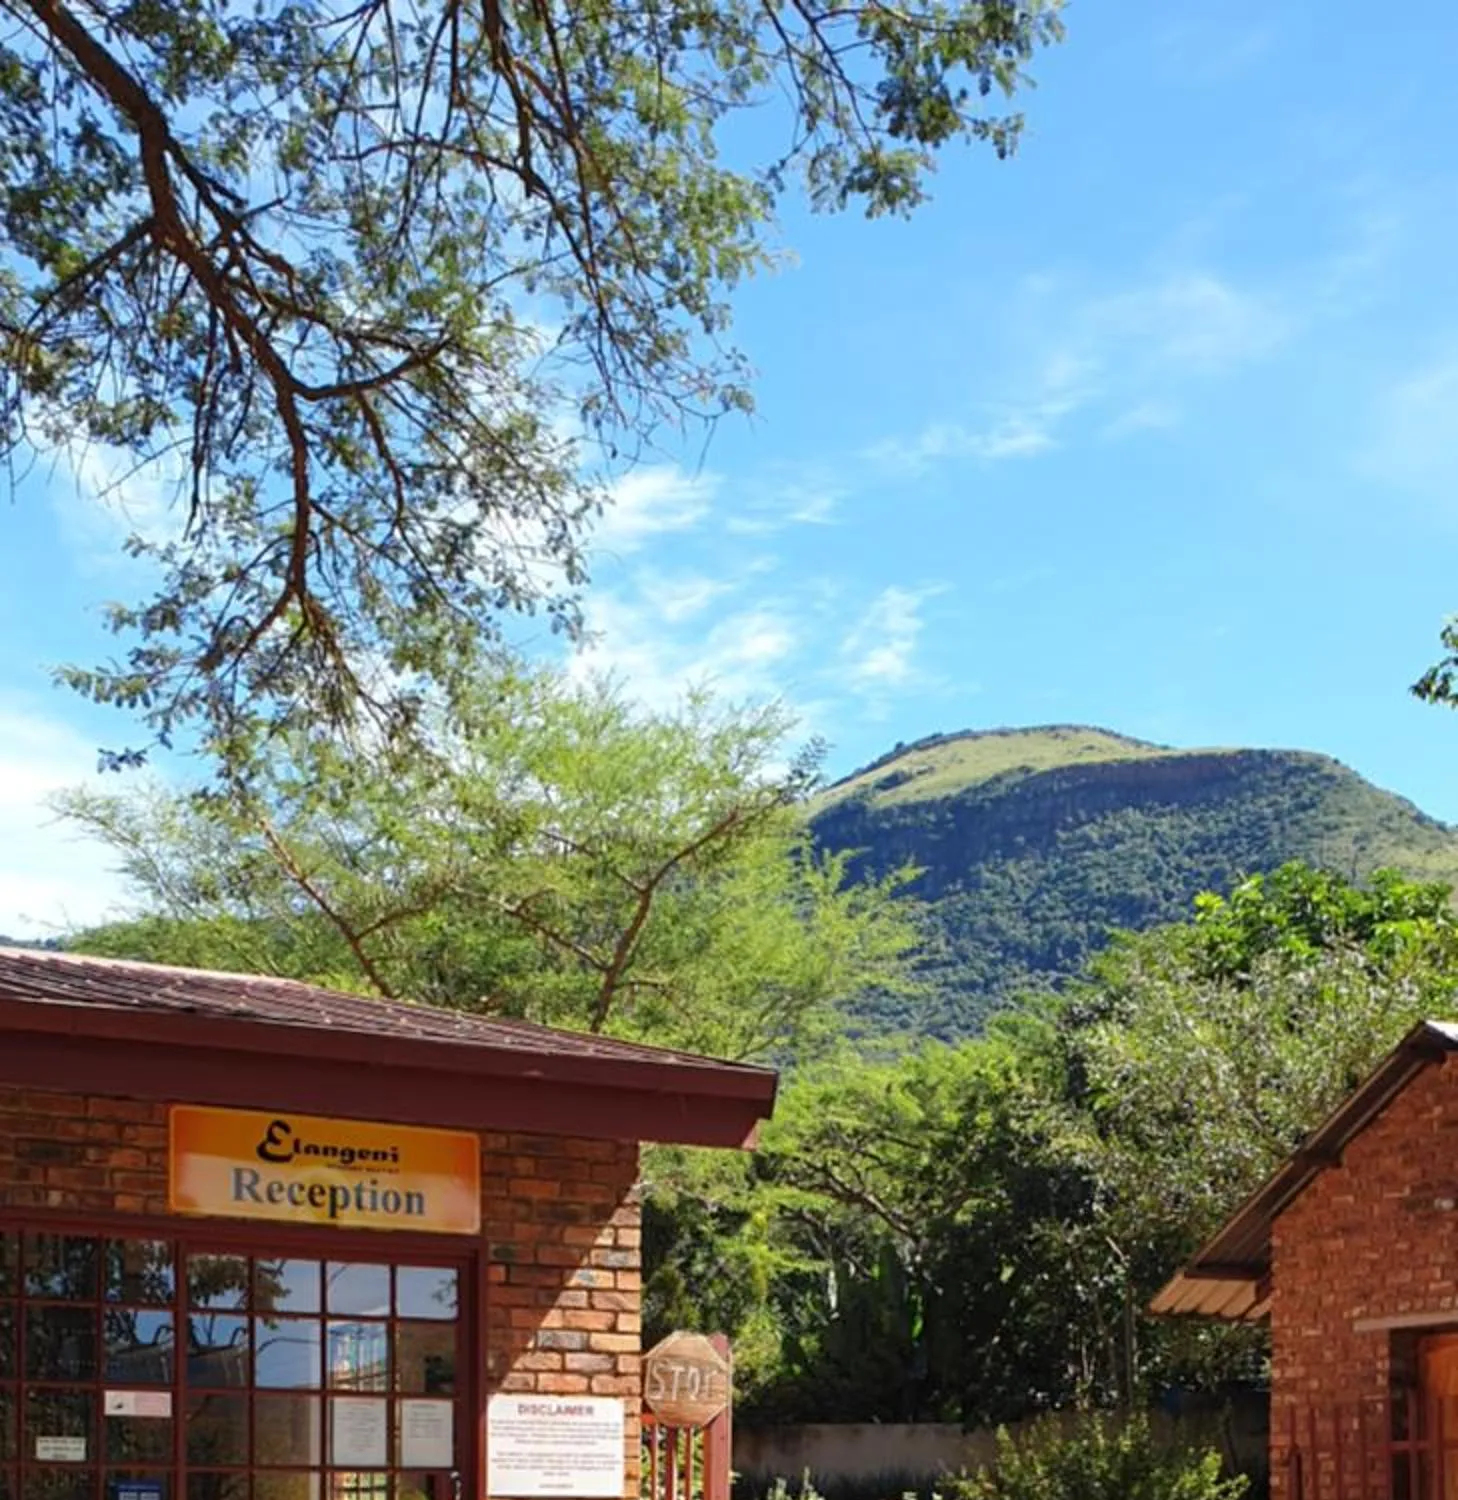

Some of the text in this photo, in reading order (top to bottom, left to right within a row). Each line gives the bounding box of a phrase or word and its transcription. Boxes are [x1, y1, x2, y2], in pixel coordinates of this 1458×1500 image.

[256, 1120, 400, 1163] Elangeni
[231, 1167, 425, 1219] Reception
[517, 1403, 595, 1416] DISCLAIMER
